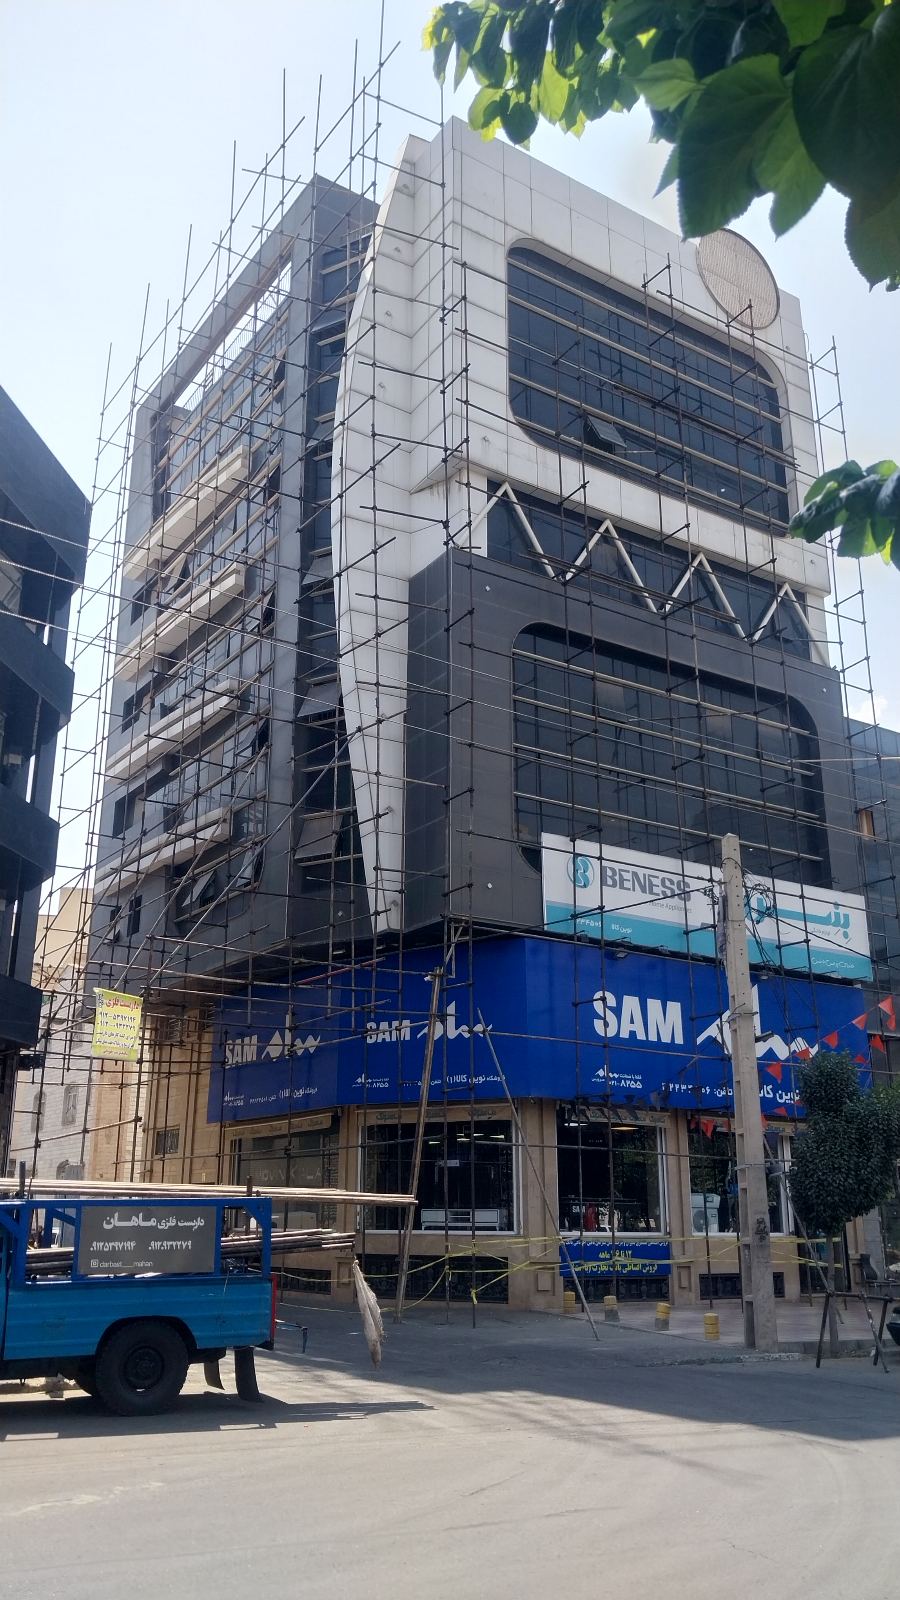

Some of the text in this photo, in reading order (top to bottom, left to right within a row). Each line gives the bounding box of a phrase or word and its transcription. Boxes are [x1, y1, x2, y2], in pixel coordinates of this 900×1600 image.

[601, 865, 691, 902] BENESS
[366, 1020, 410, 1044] SAM
[417, 1001, 492, 1041] سام
[593, 991, 683, 1045] SAM
[225, 1034, 258, 1066] SAM
[261, 1014, 321, 1062] سام
[776, 1089, 800, 1103] نوین
[102, 1211, 205, 1231] داربست فلزی ماهان
